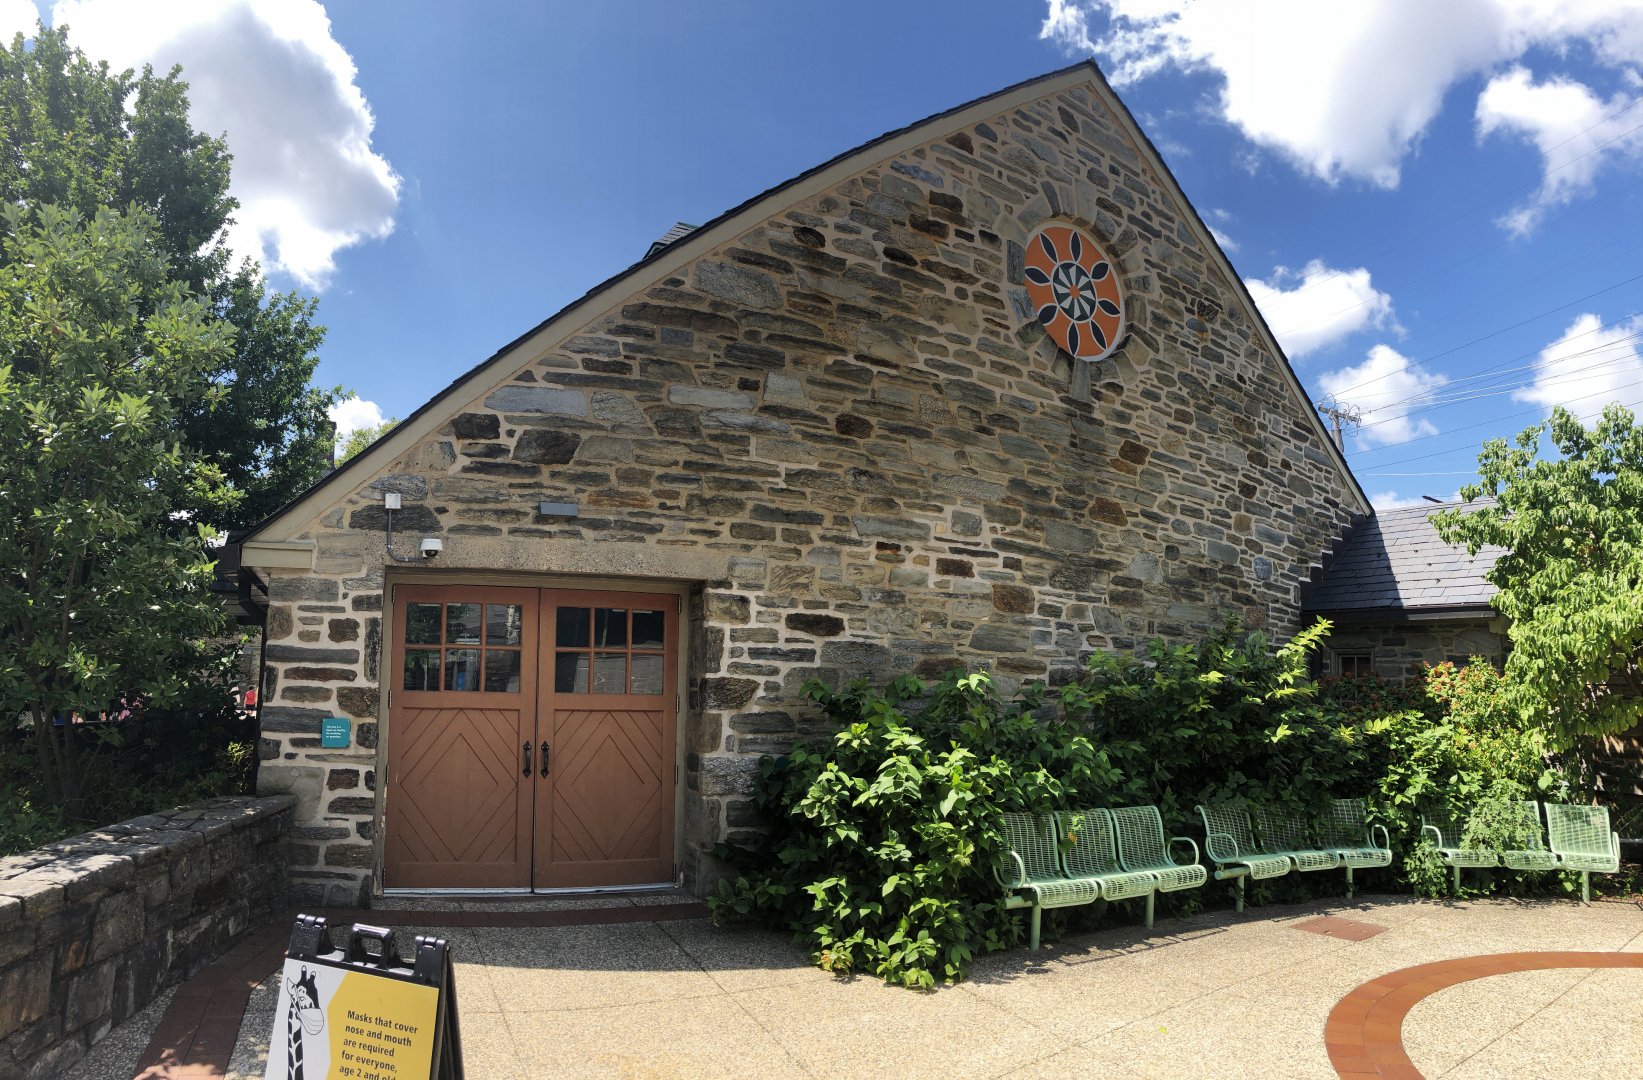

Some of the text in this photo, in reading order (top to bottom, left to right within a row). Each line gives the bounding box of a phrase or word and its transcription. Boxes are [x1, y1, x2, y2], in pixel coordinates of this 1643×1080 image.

[348, 1010, 418, 1034] Masks that cover
[344, 1038, 394, 1056] are required
[346, 1026, 412, 1047] nose and mouth
[342, 1050, 397, 1073] for everyone,
[339, 1066, 354, 1076] age
[356, 1068, 362, 1077] 2
[364, 1072, 380, 1080] and
